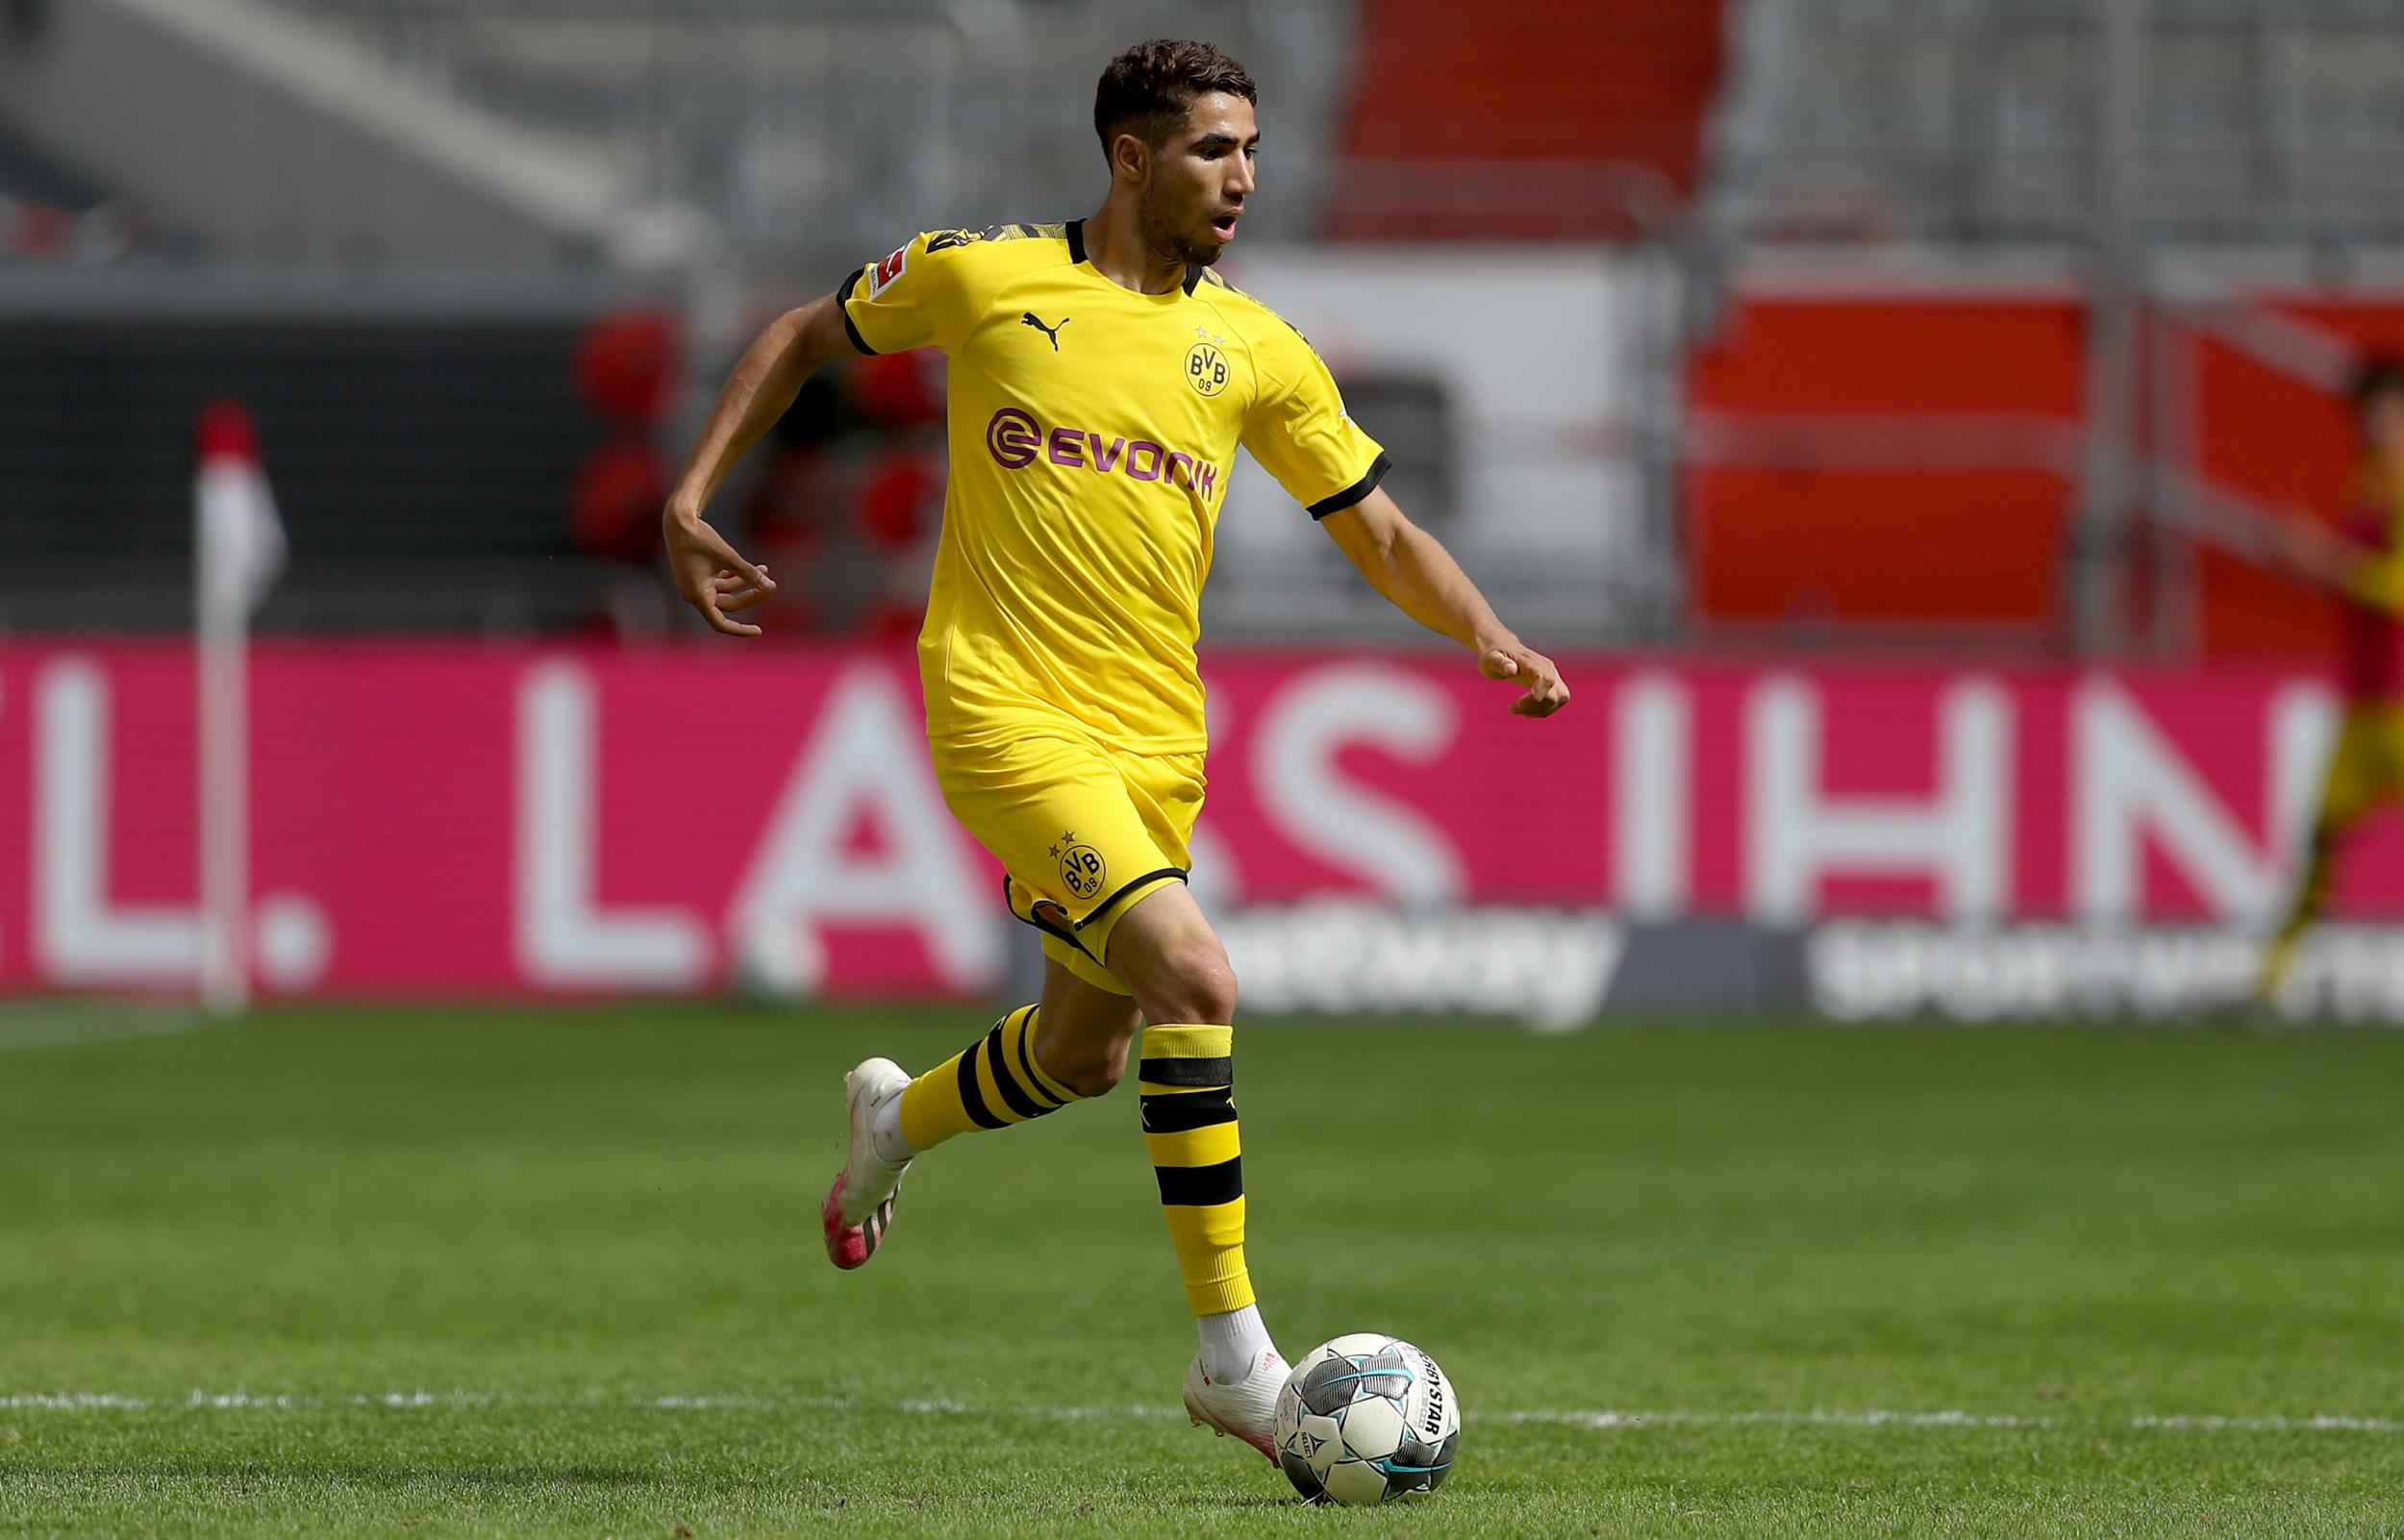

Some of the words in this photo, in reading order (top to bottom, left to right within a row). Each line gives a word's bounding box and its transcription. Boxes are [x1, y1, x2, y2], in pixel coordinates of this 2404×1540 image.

[1190, 347, 1226, 385] BVB
[1198, 378, 1212, 392] 09
[1048, 427, 1217, 503] EVONIK
[0, 656, 332, 992] L.
[514, 657, 1466, 998] LAS
[1064, 851, 1100, 892] BVB
[1084, 877, 1097, 893] 09
[1301, 1431, 1313, 1458] SELECT
